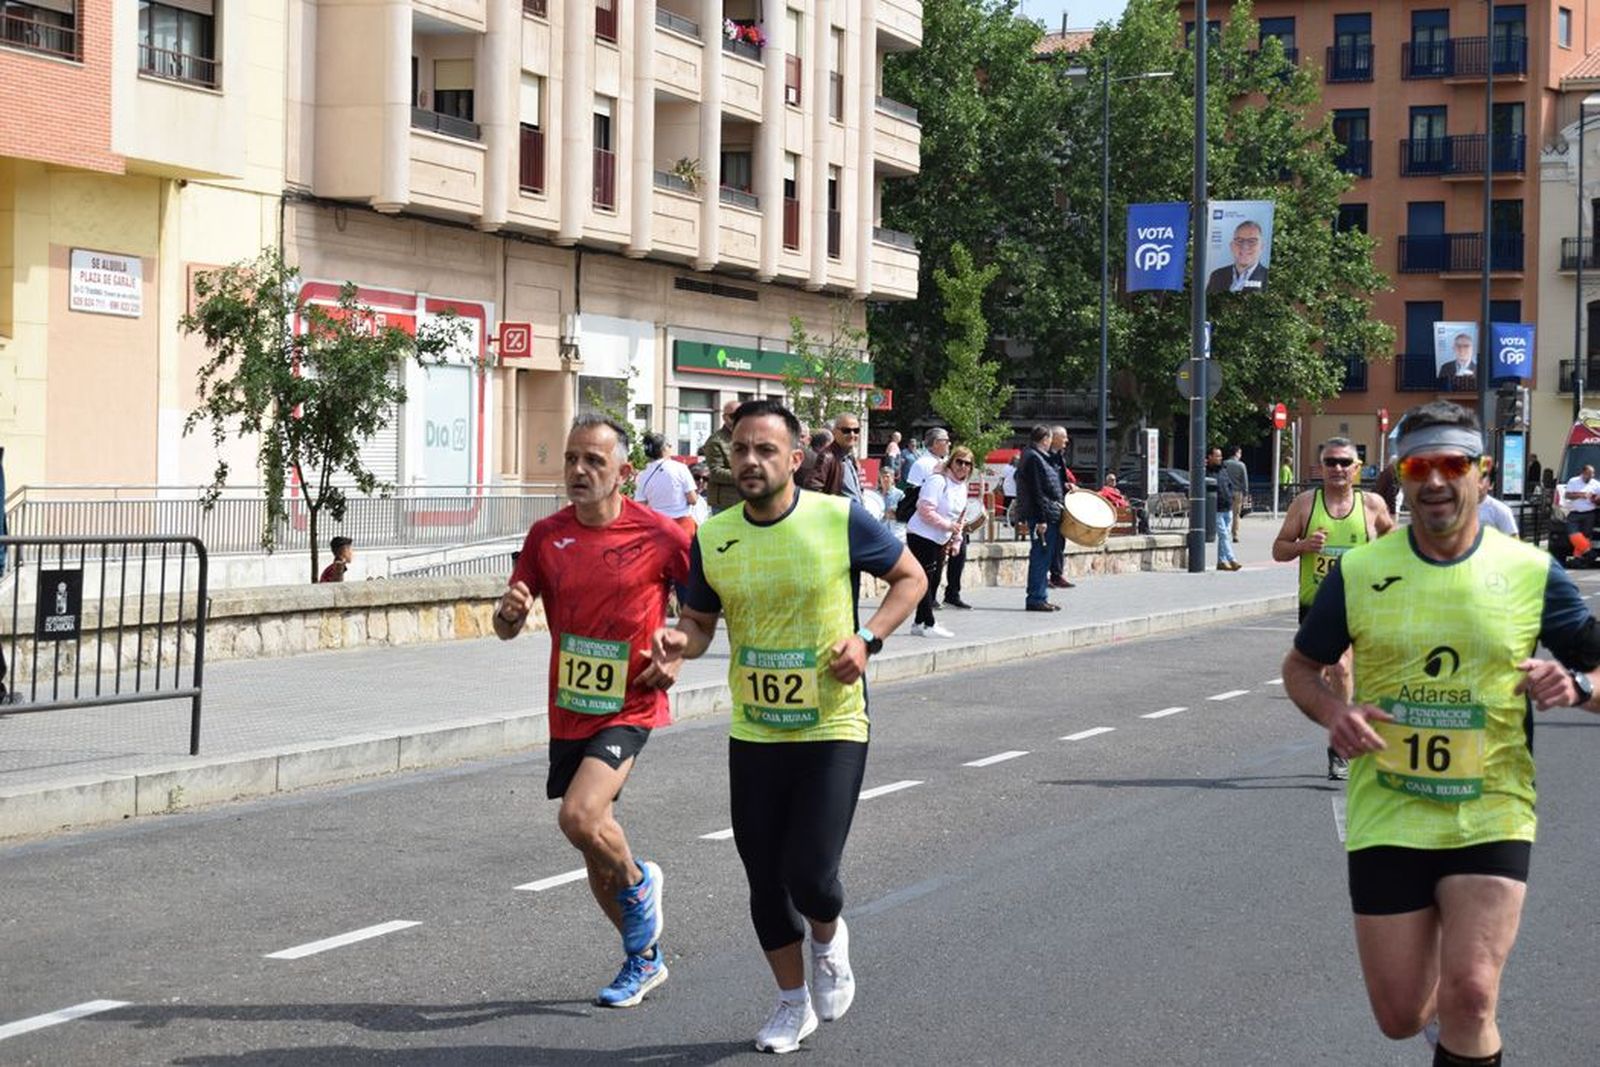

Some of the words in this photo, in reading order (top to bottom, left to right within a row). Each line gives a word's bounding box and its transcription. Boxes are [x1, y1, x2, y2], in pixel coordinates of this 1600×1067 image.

[1137, 226, 1174, 240] VOTA
[91, 257, 100, 269] SE
[80, 270, 101, 284] PLAZA
[103, 273, 111, 286] DE
[1500, 337, 1526, 347] VOTA
[565, 658, 614, 692] 129
[747, 671, 804, 704] 162
[1397, 684, 1472, 704] Adarsa
[782, 712, 815, 723] RURAL
[1402, 733, 1451, 773] 16
[1406, 781, 1433, 794] CAJA
[1436, 783, 1476, 796] RURAL
